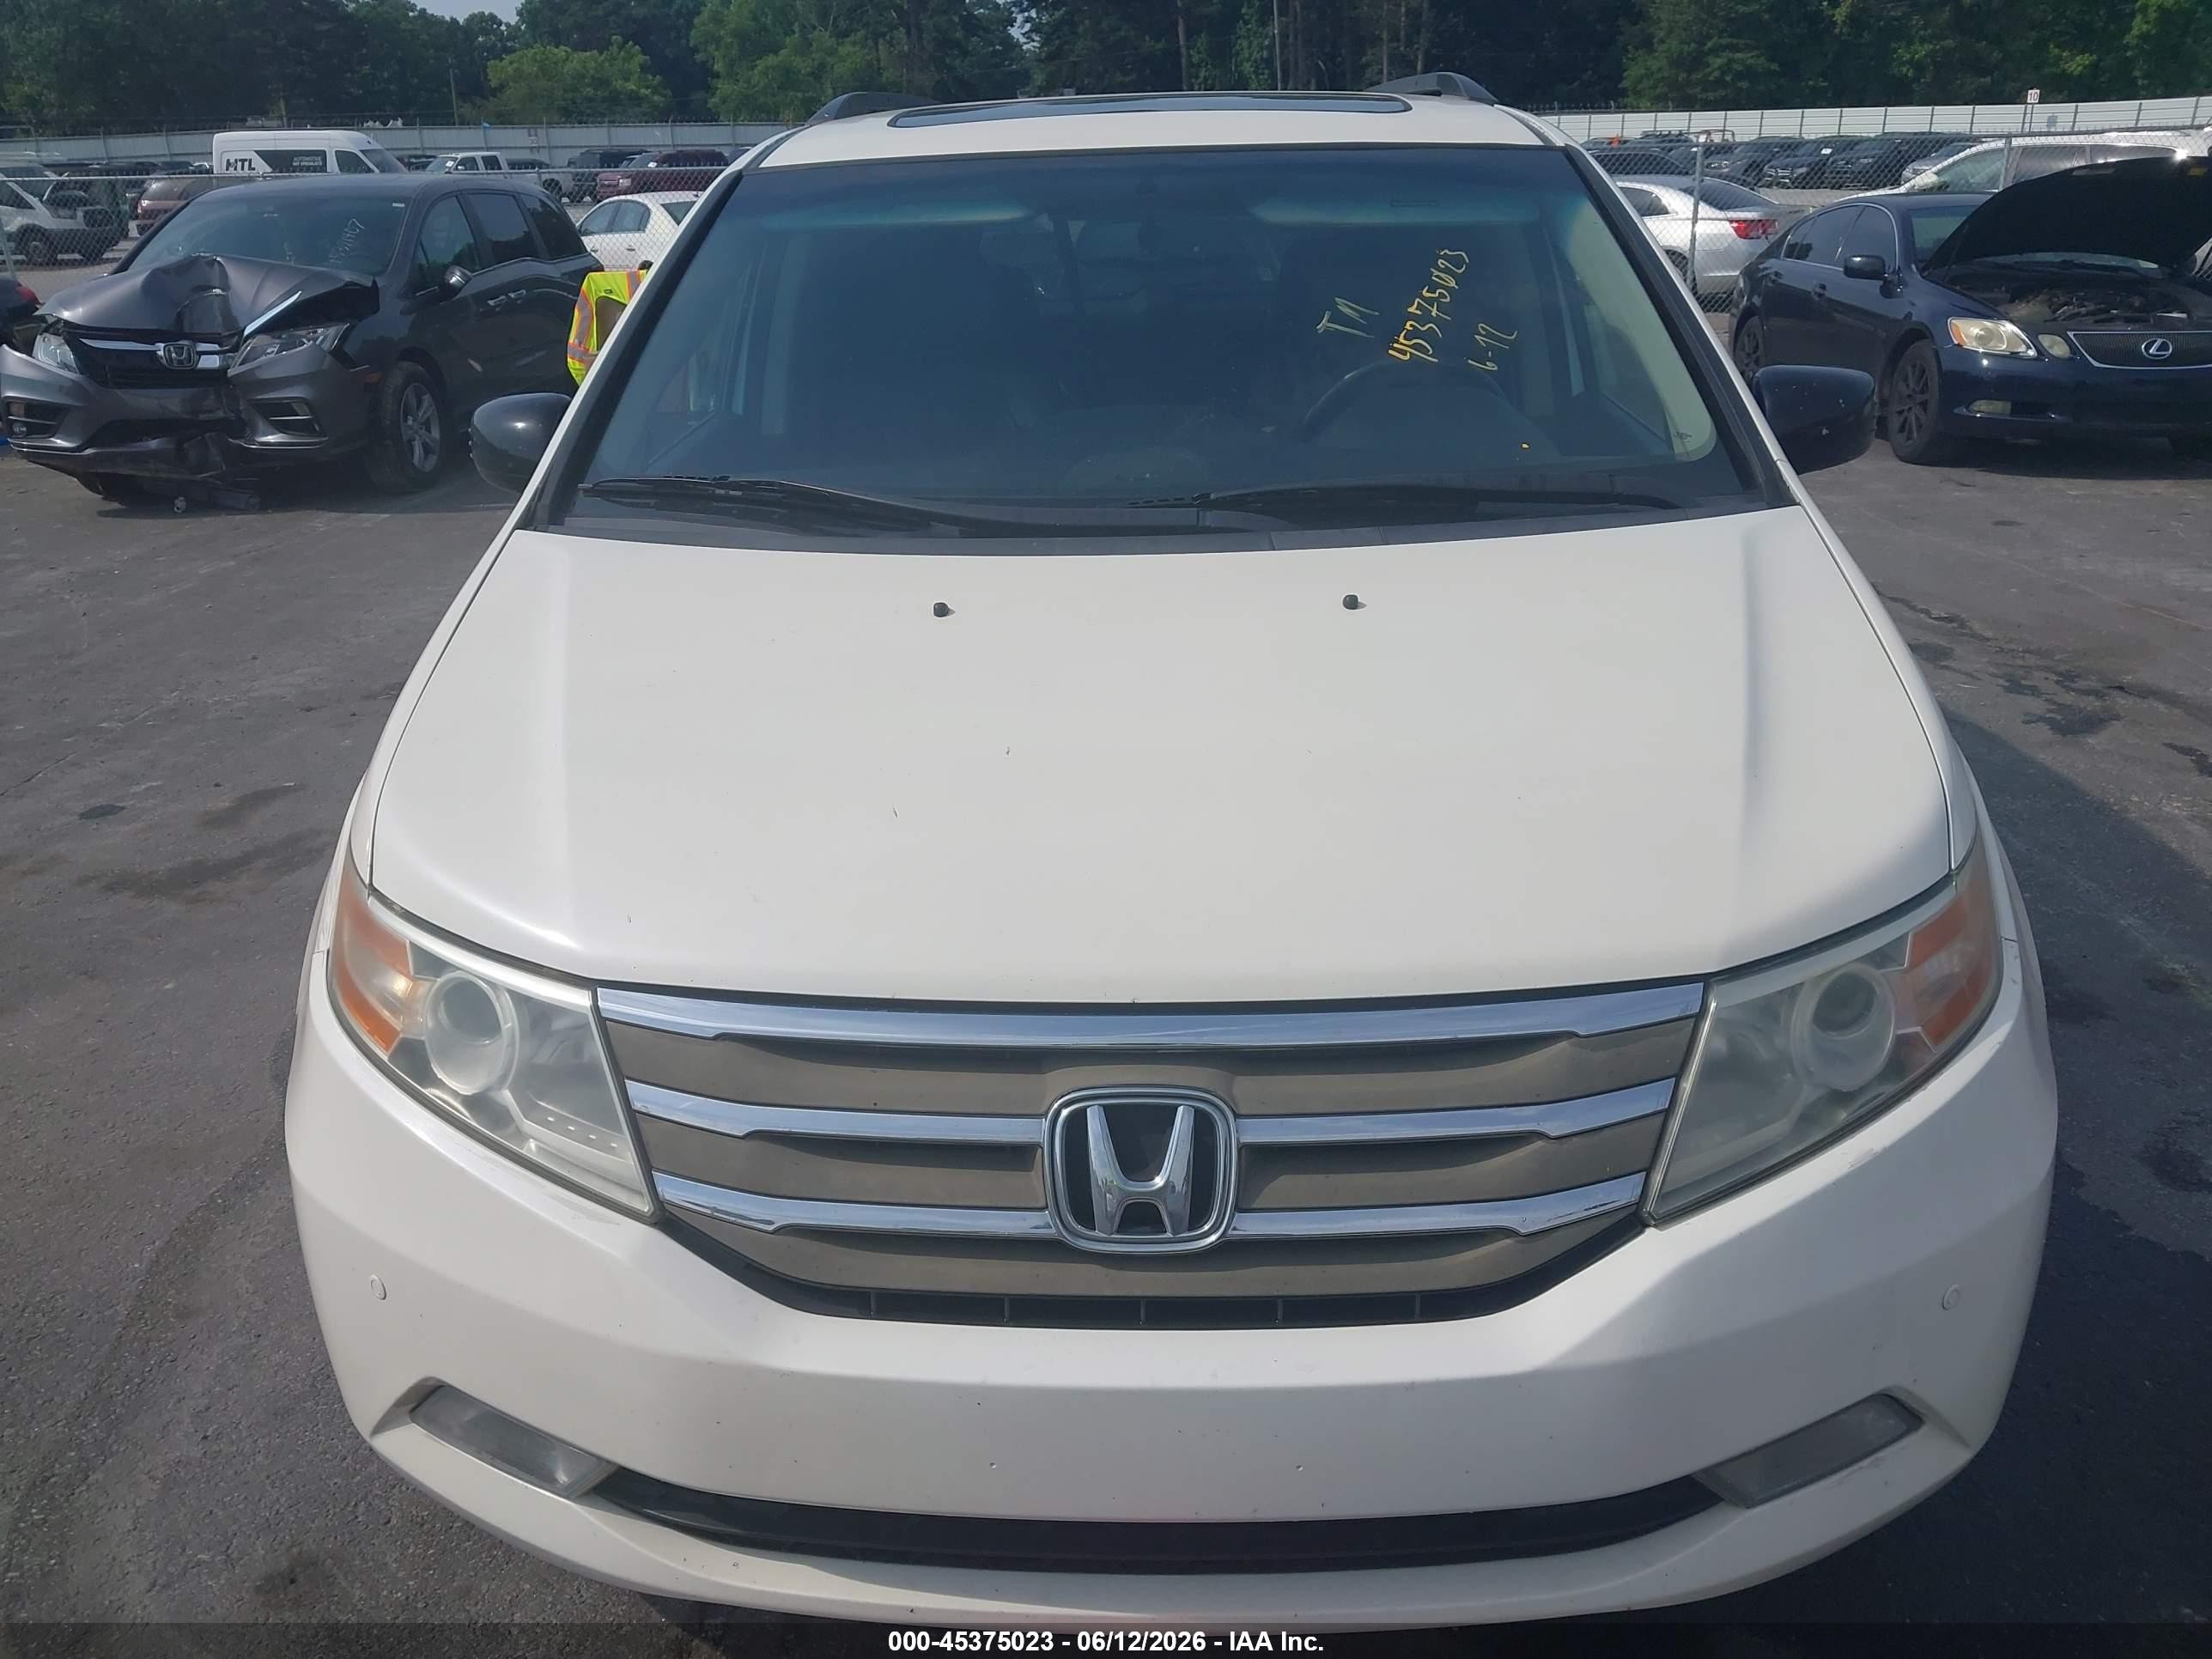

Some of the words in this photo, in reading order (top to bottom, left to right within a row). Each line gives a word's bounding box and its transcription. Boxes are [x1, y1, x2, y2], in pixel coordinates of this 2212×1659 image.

[2029, 91, 2039, 101] 10
[225, 158, 256, 171] MTL
[1388, 248, 1469, 362] 45375023
[1465, 323, 1518, 371] 6-12
